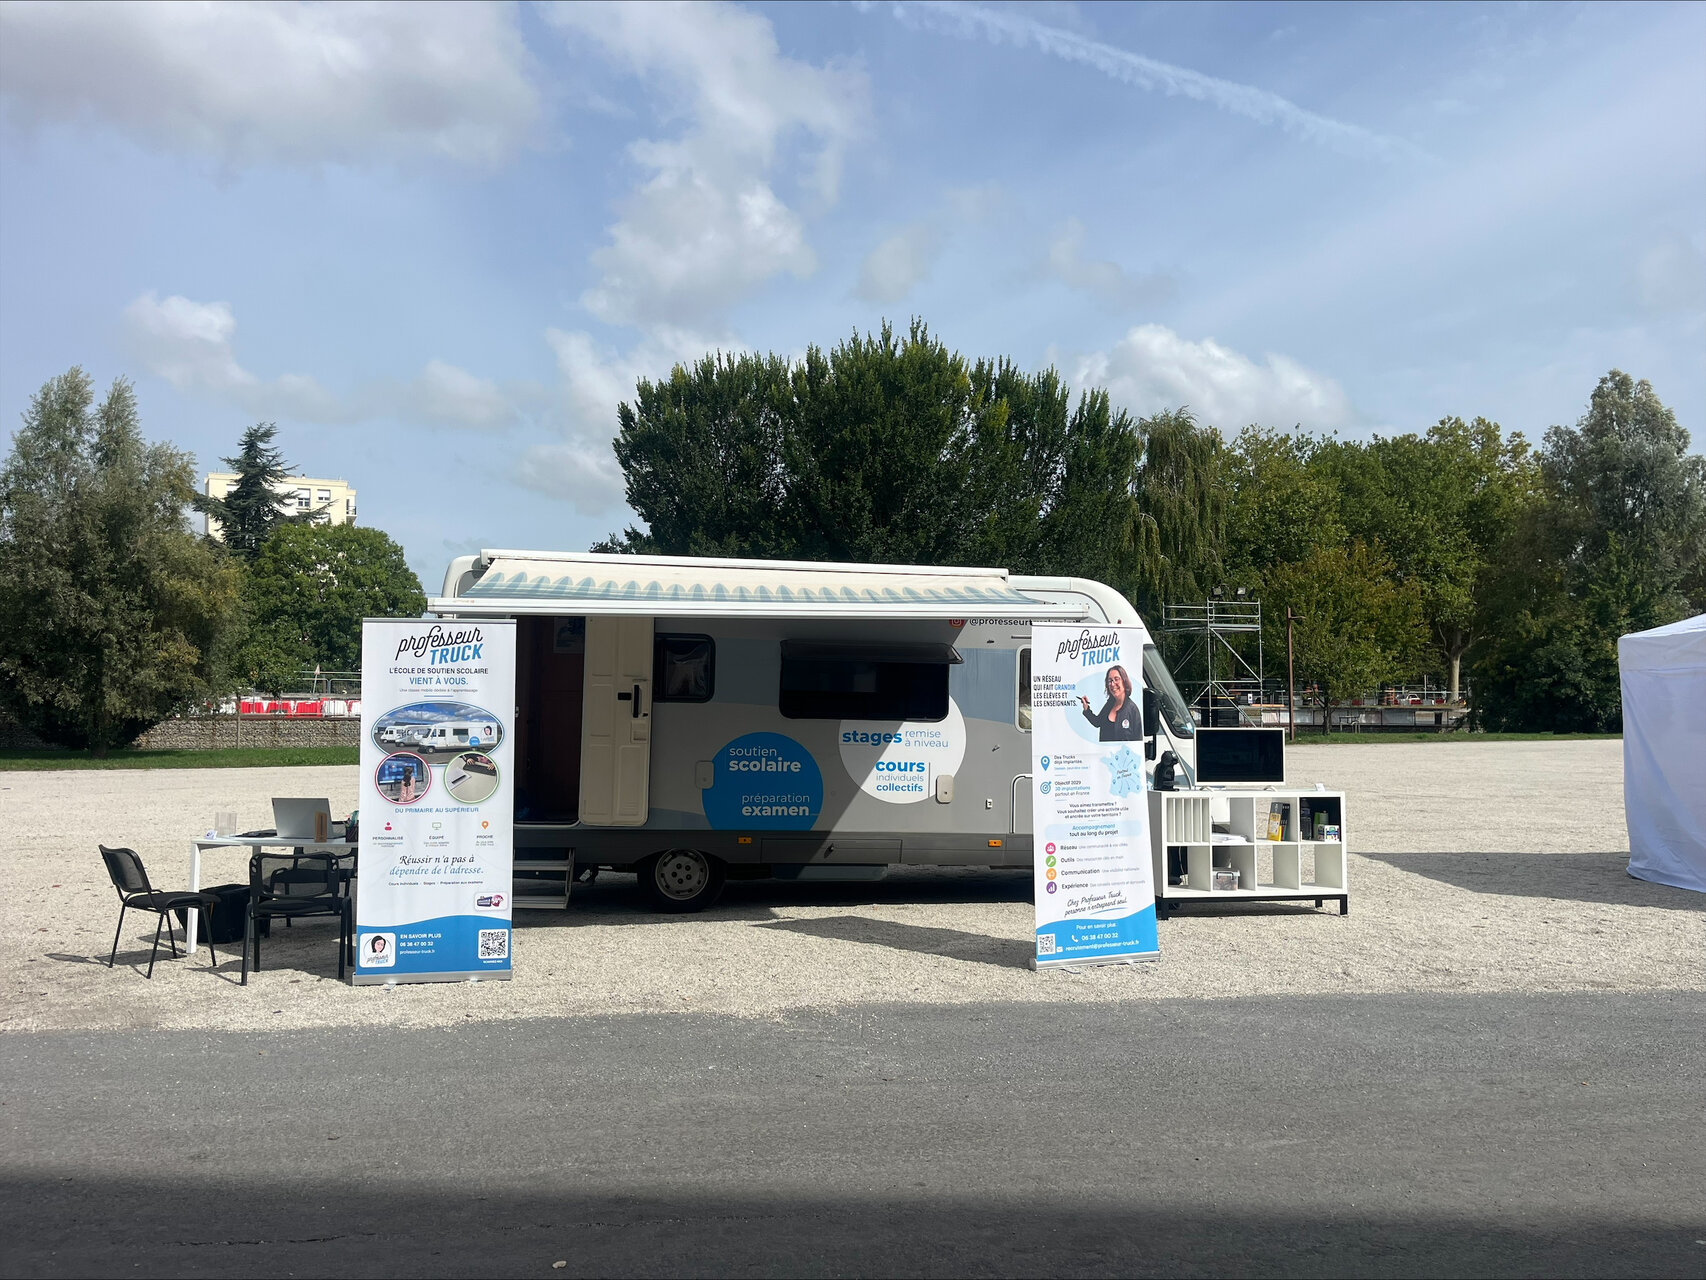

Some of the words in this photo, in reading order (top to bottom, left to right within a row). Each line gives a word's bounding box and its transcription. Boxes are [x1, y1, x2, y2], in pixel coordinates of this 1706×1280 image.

[395, 625, 483, 660] professeur
[1056, 629, 1120, 662] professeur
[430, 644, 483, 665] TRUCK
[1082, 647, 1120, 667] TRUCK
[409, 677, 433, 685] VIENT
[436, 675, 441, 685] À
[444, 677, 468, 685] VOUS.
[1042, 675, 1062, 683] RÉSEAU
[1043, 691, 1061, 699] ÉLÈVES
[842, 729, 903, 747] stages
[905, 729, 941, 739] remise
[905, 737, 911, 747] à
[914, 739, 949, 748] niveau
[729, 746, 777, 757] soutien
[728, 758, 801, 772] scolaire
[875, 760, 925, 773] cours
[876, 773, 924, 782] individuels
[876, 783, 923, 792] collectifs
[741, 792, 810, 806] préparation
[741, 804, 810, 817] examen
[400, 854, 432, 865] Réussir
[435, 855, 449, 864] n'a
[451, 856, 466, 865] pas
[468, 854, 474, 863] à
[390, 866, 429, 878] dépendre
[431, 866, 441, 875] de
[444, 865, 484, 874] l'adresse.
[1067, 898, 1079, 907] Chez
[1064, 906, 1086, 918] personne
